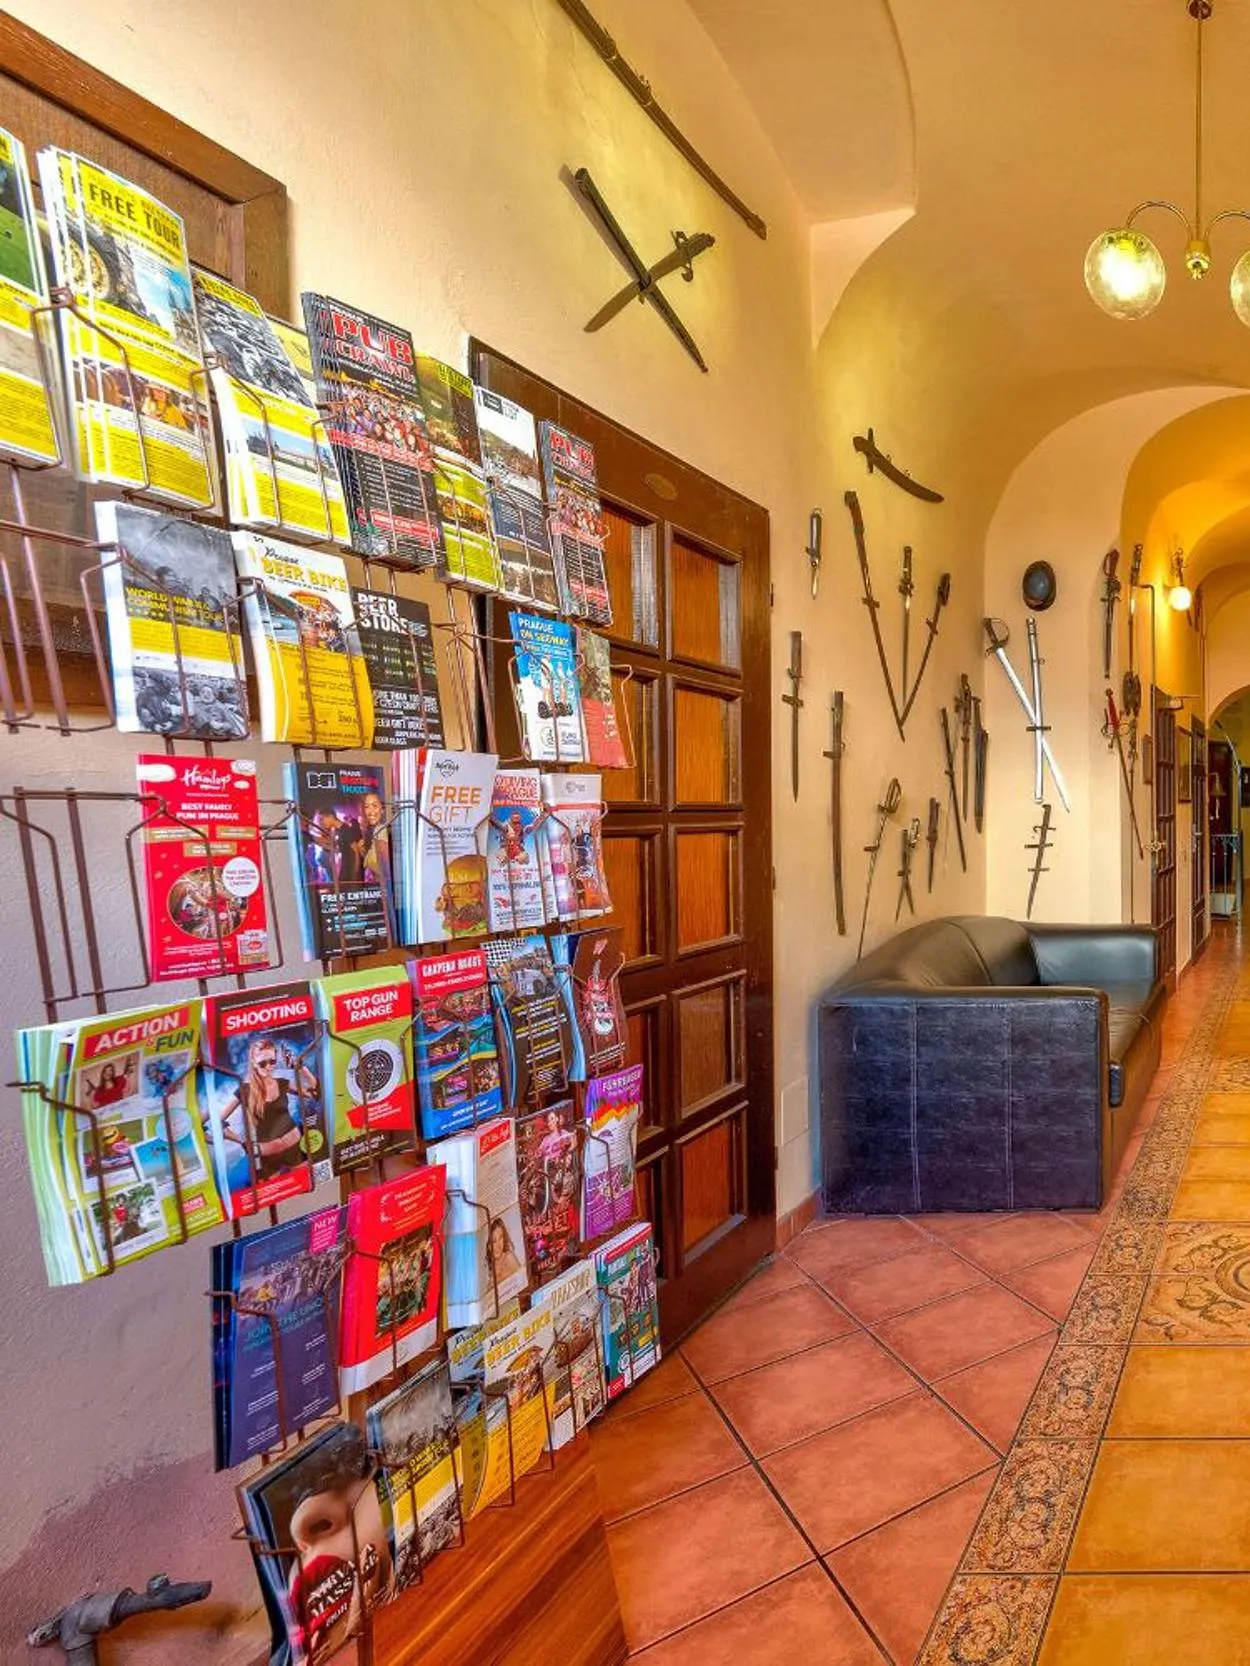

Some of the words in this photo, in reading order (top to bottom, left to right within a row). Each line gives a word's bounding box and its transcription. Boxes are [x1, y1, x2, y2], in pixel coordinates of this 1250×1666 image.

[89, 183, 136, 223] FREE
[143, 211, 181, 249] TOUR
[331, 311, 414, 366] PUB
[550, 431, 595, 470] PUB
[307, 565, 347, 592] BIKE
[431, 785, 482, 804] FREE
[430, 805, 473, 825] GIFT
[343, 996, 370, 1011] TOP
[371, 990, 399, 1006] GUN
[350, 1003, 394, 1023] RANGE
[226, 1001, 308, 1031] SHOOTING
[95, 1012, 180, 1057] ACTION
[155, 1028, 194, 1053] FUN
[314, 1215, 338, 1232] NEW
